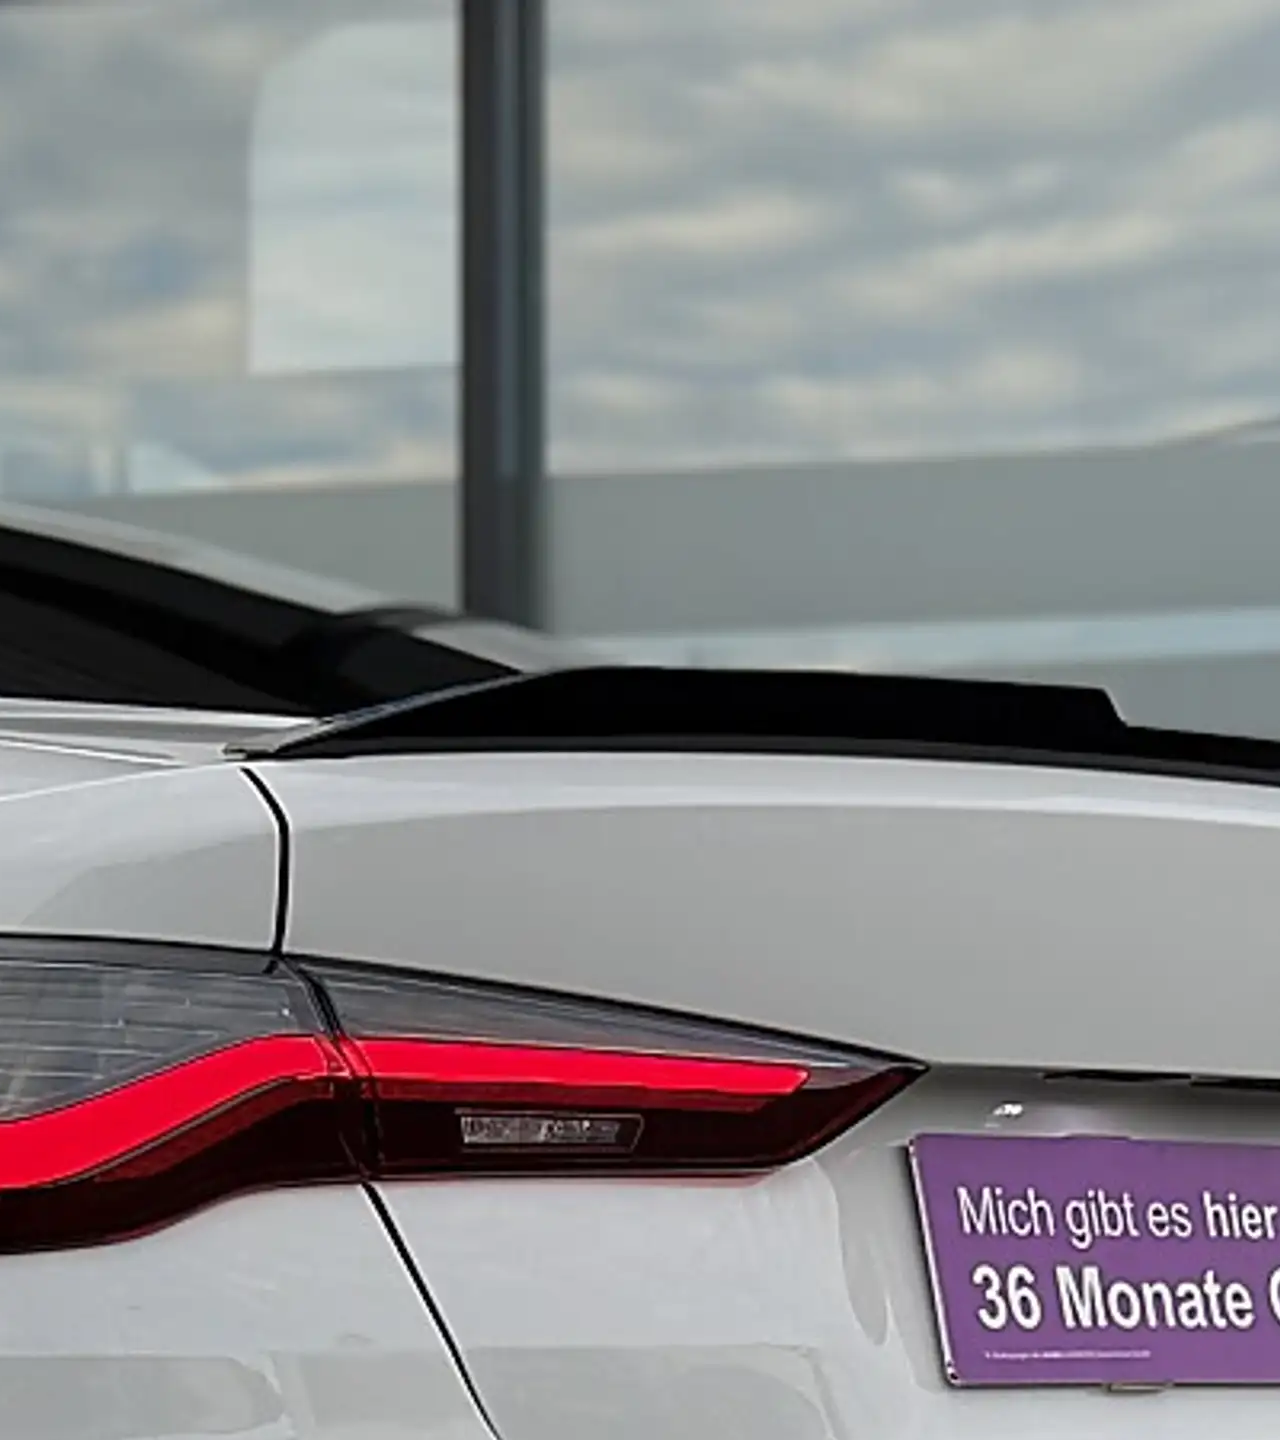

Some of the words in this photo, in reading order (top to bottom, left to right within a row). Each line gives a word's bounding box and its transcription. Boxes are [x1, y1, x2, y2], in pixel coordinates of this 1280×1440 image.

[956, 1185, 1056, 1237] Mich
[1065, 1189, 1140, 1250] gibt
[1147, 1202, 1193, 1238] es
[1202, 1191, 1278, 1239] hier
[972, 1265, 1042, 1330] 36
[1055, 1265, 1256, 1330] Monate
